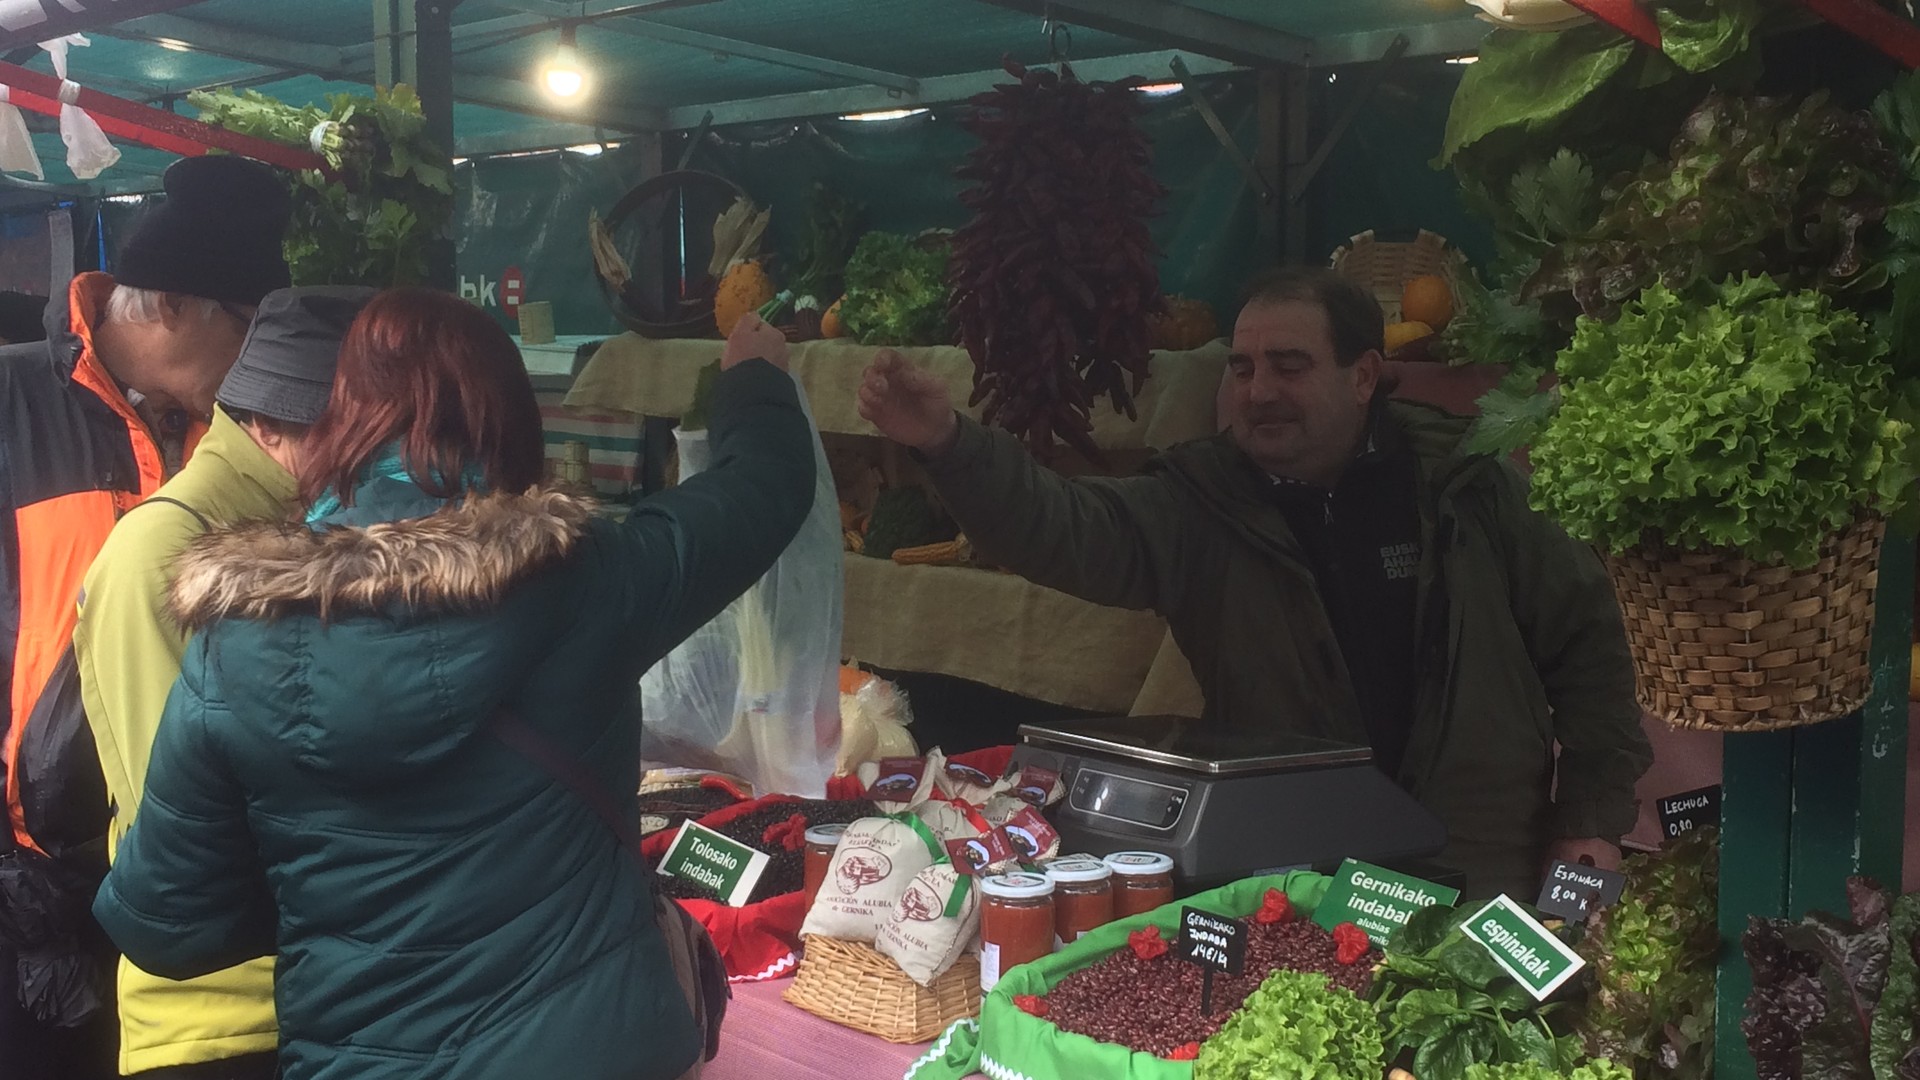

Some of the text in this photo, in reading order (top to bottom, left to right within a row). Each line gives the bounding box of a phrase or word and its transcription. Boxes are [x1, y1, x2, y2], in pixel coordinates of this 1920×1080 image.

[690, 837, 738, 870] Tolosako
[680, 857, 725, 890] indabak
[1350, 871, 1437, 907] Gernikako
[1187, 912, 1236, 936] GERNIKAKO
[1356, 917, 1391, 934] alubias
[1481, 918, 1550, 979] espinakak
